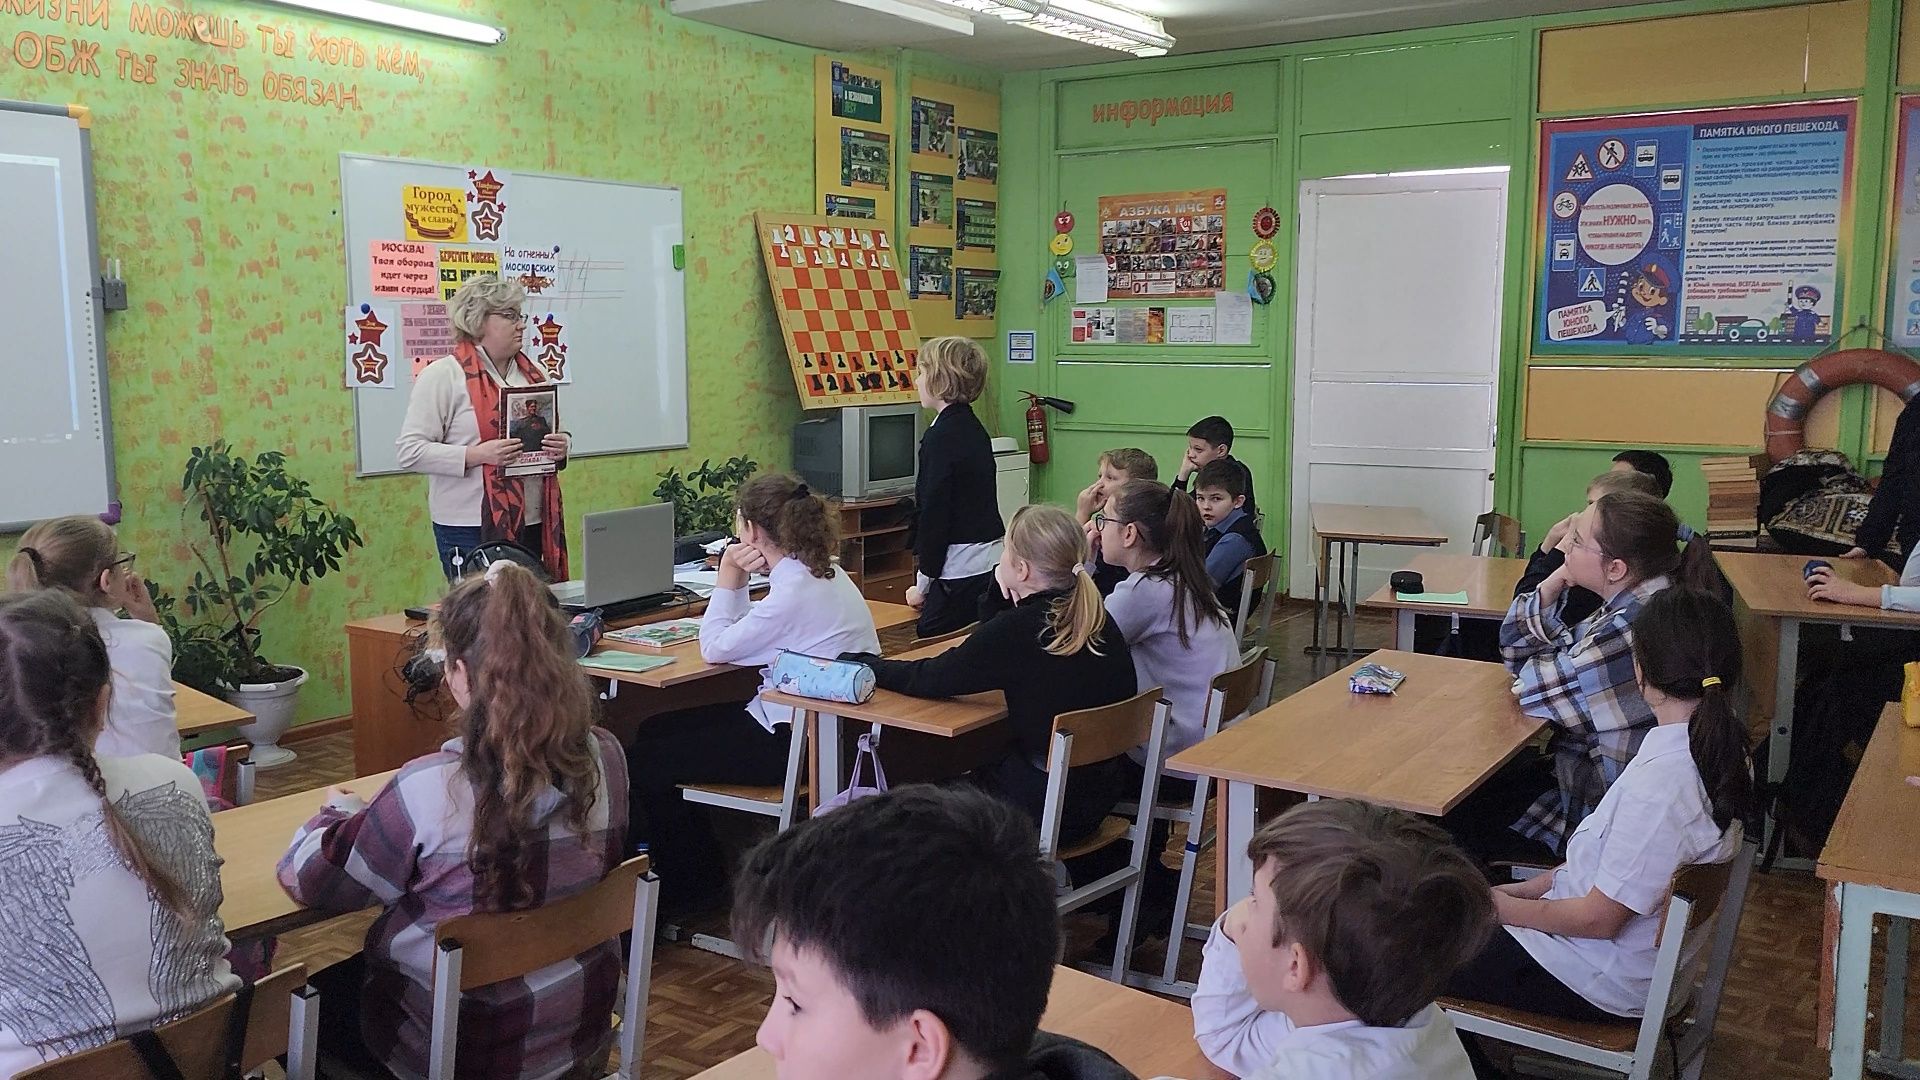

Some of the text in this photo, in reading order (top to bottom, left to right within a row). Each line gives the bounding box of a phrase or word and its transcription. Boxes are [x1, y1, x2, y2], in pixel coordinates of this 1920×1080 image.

[256, 24, 296, 59] ТЫ
[13, 30, 101, 78] ОБЖ
[116, 48, 158, 84] ТЫ
[174, 57, 249, 96] ЗНАТЬ
[1700, 121, 1839, 138] ПАМЯТКА ЮНОГО ПЕШЕХОДА
[413, 186, 452, 203] Город
[406, 203, 459, 215] мужества
[1119, 203, 1205, 217] АЗБУКА МЧС
[1603, 214, 1637, 226] НУЖНО
[504, 246, 515, 258] На
[1133, 282, 1149, 293] 01
[1558, 304, 1593, 319] ПАМЯТКА
[1563, 315, 1589, 328] ЮНОГО
[1557, 323, 1598, 339] ПЕШЕХОДА
